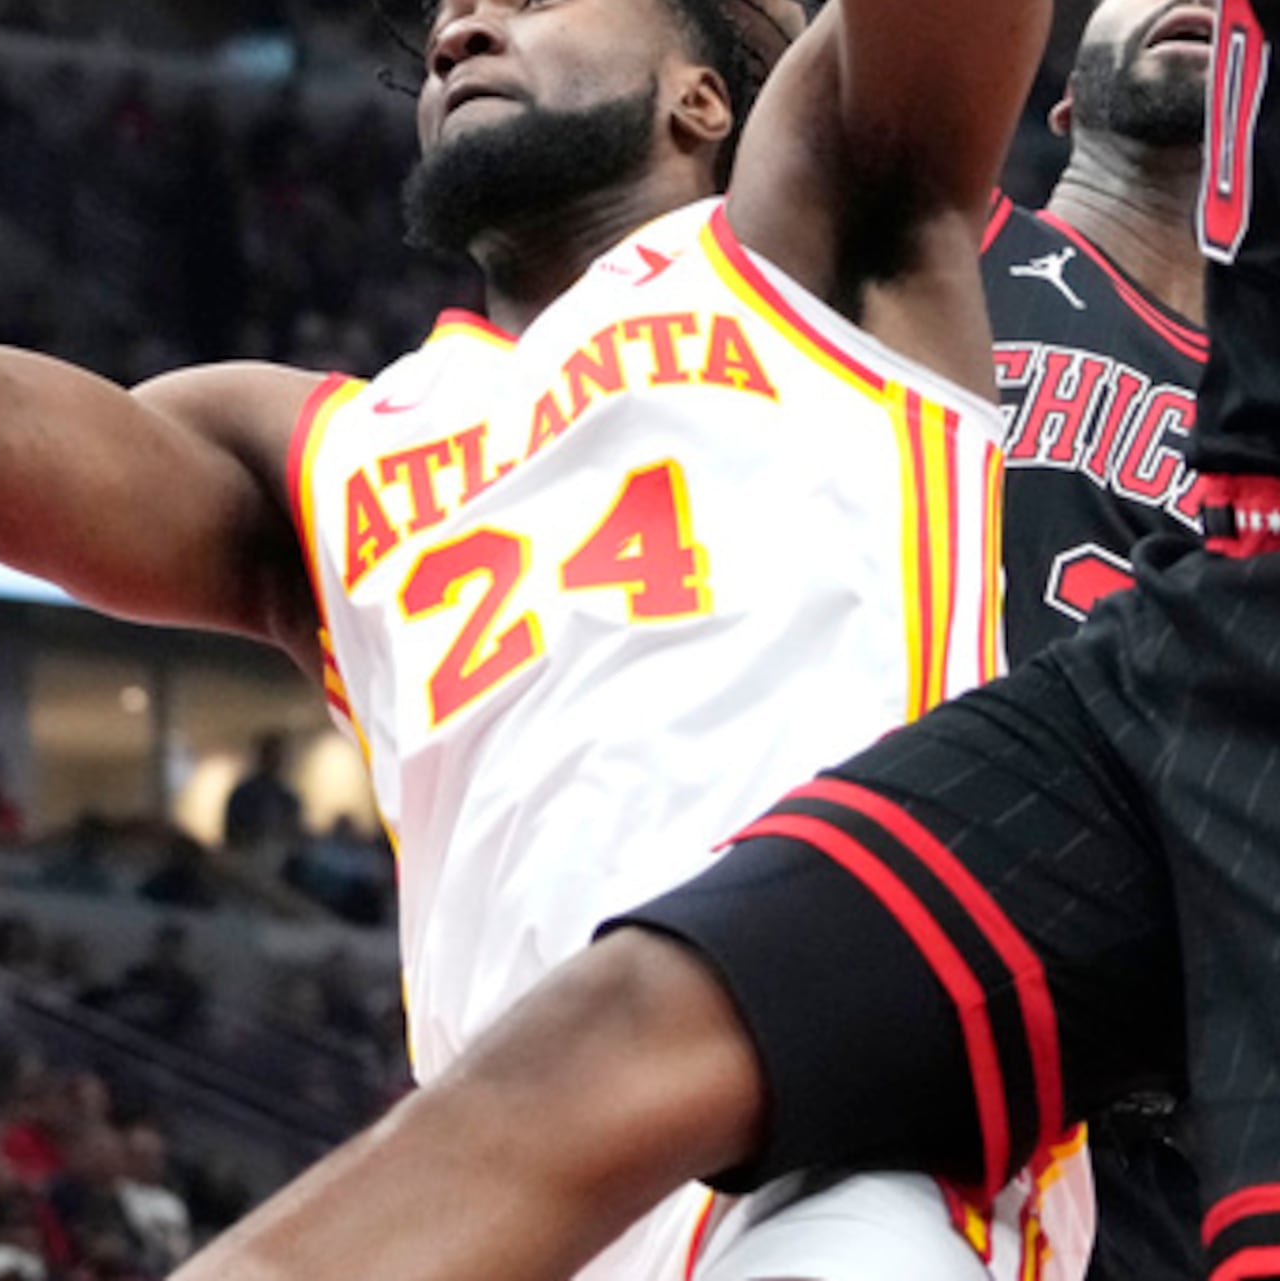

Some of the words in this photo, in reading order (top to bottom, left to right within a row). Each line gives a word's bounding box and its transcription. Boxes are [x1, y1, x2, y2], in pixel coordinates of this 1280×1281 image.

[343, 312, 780, 595] ATLANTA
[992, 341, 1204, 535] CHIC
[397, 457, 713, 731] 24
